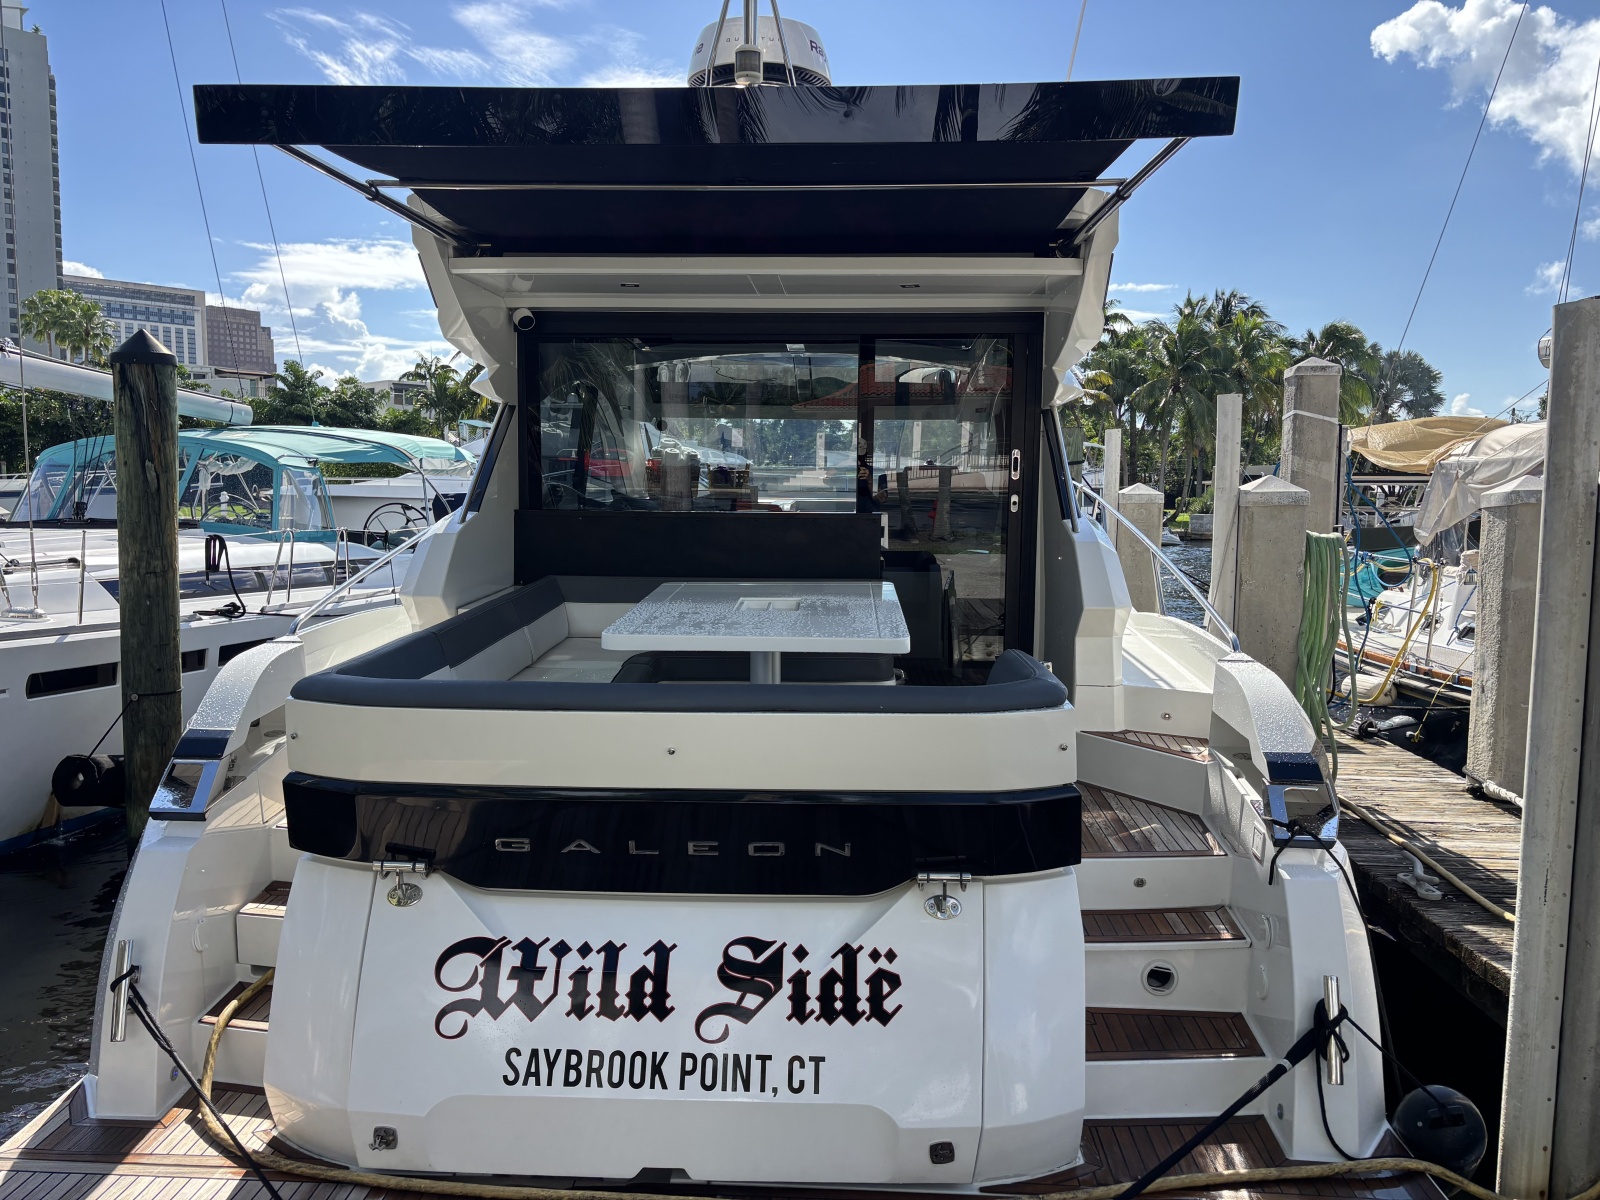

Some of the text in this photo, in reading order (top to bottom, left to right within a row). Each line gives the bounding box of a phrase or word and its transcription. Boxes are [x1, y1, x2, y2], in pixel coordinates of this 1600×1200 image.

[495, 837, 851, 858] GALEON
[434, 935, 678, 1040] Wild
[502, 1046, 826, 1098] SAYBROOK POINT, CT
